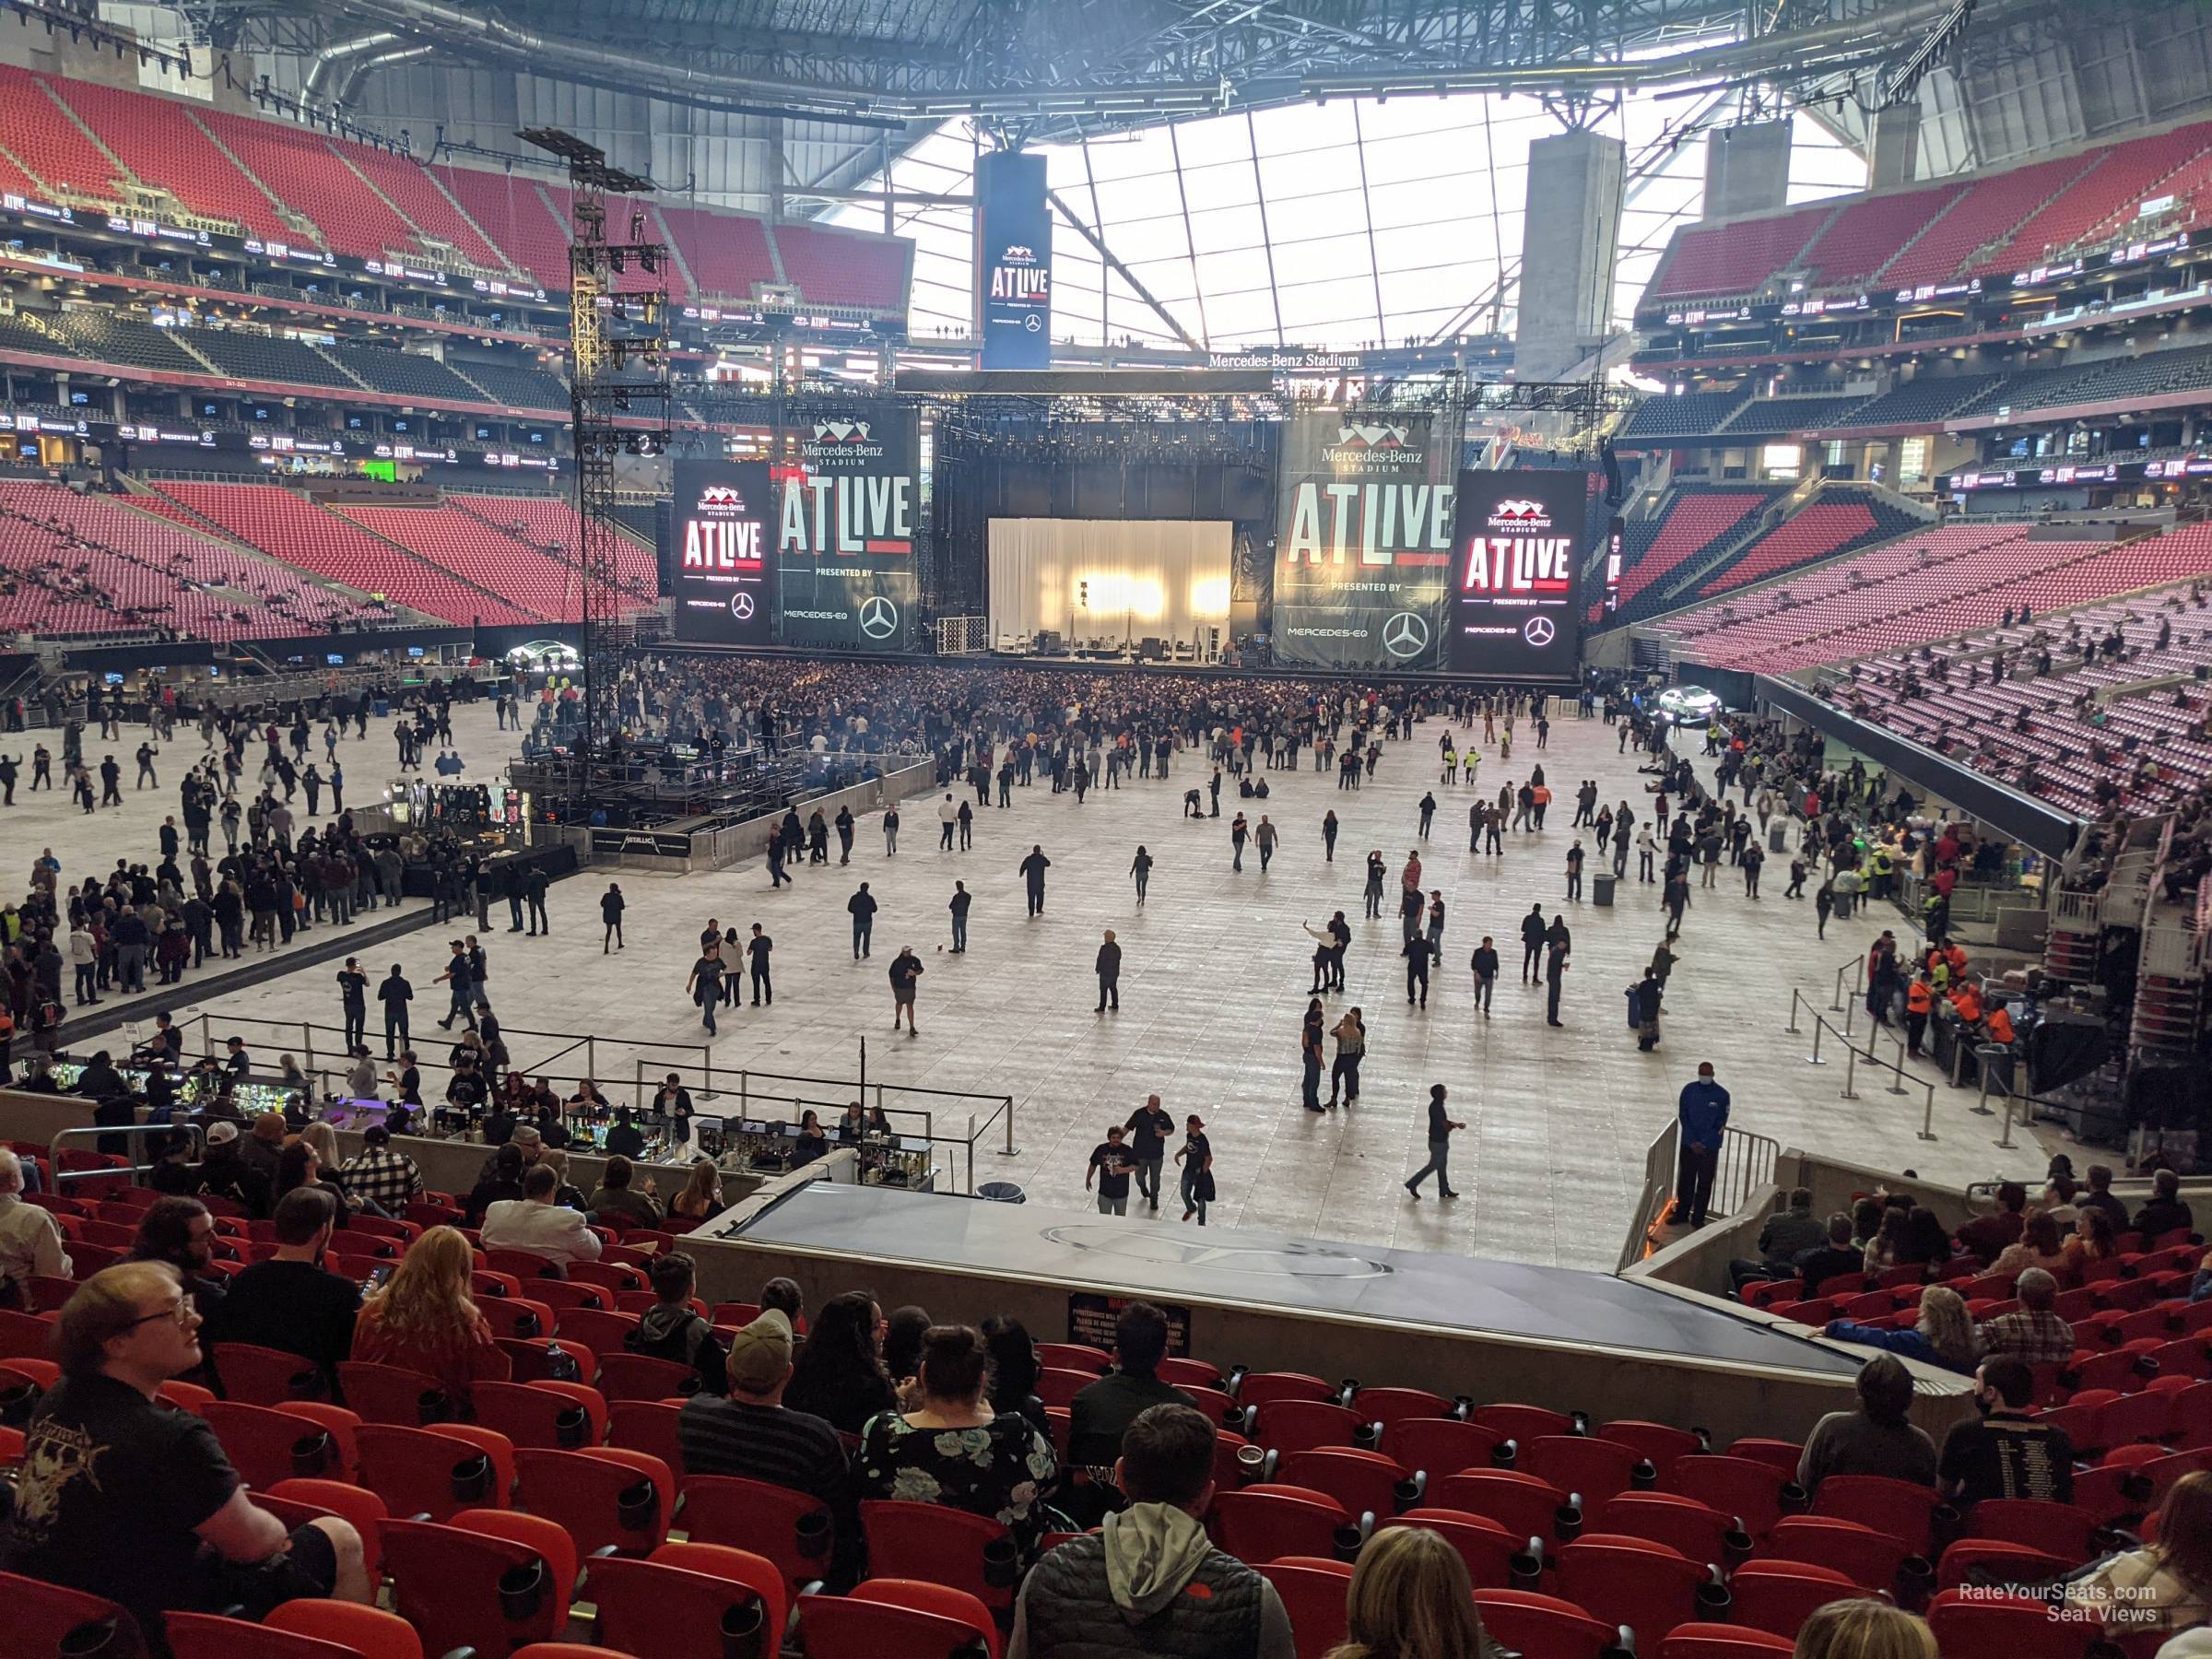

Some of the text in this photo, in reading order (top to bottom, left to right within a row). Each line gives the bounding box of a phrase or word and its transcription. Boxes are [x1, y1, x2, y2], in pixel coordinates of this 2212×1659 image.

[1209, 353, 1359, 368] Mercedes-Benz Stadium
[802, 443, 883, 457] Mercedes-Benz
[1322, 448, 1422, 464] Mercedes-Benz
[1343, 465, 1400, 474] STADIUM
[698, 501, 745, 512] Mercedes-Benz
[779, 476, 912, 554] ATLIVE
[1488, 516, 1551, 528] Mercedes-Benz
[1287, 482, 1453, 566] ATLIVE
[684, 520, 761, 568] ATLIVE
[1465, 537, 1571, 590] ATLIVE
[816, 568, 872, 578] PRESENTED BY
[1332, 582, 1401, 593] PRESENTED BY
[784, 610, 848, 620] MERCEDES-EQ
[1288, 628, 1369, 638] MERCEDES-EQ
[620, 833, 661, 854] METALLICA
